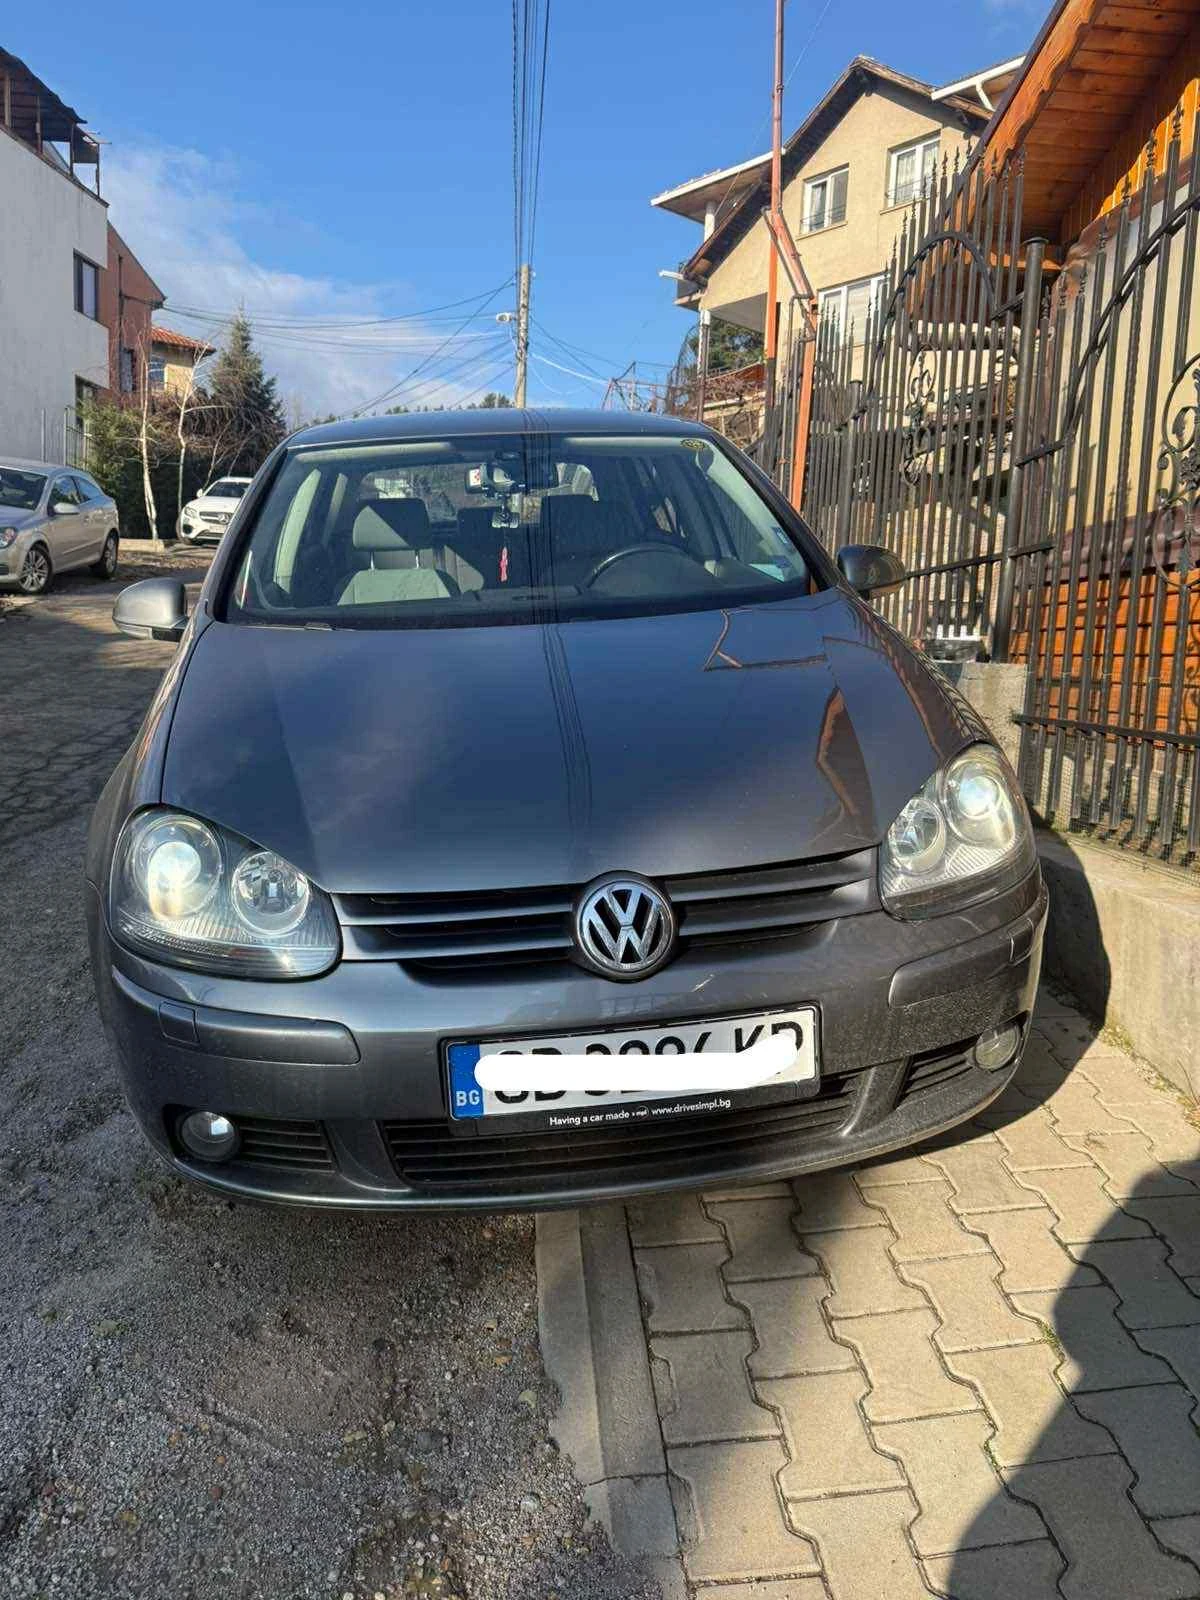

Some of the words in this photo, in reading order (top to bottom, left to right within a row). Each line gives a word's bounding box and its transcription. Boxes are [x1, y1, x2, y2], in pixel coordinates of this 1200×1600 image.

[580, 882, 671, 972] VW
[456, 1089, 480, 1106] BG
[550, 1116, 581, 1126] Having
[589, 1114, 604, 1122] car
[605, 1111, 630, 1121] made
[651, 1098, 731, 1116] www.drivesimpl.bg
